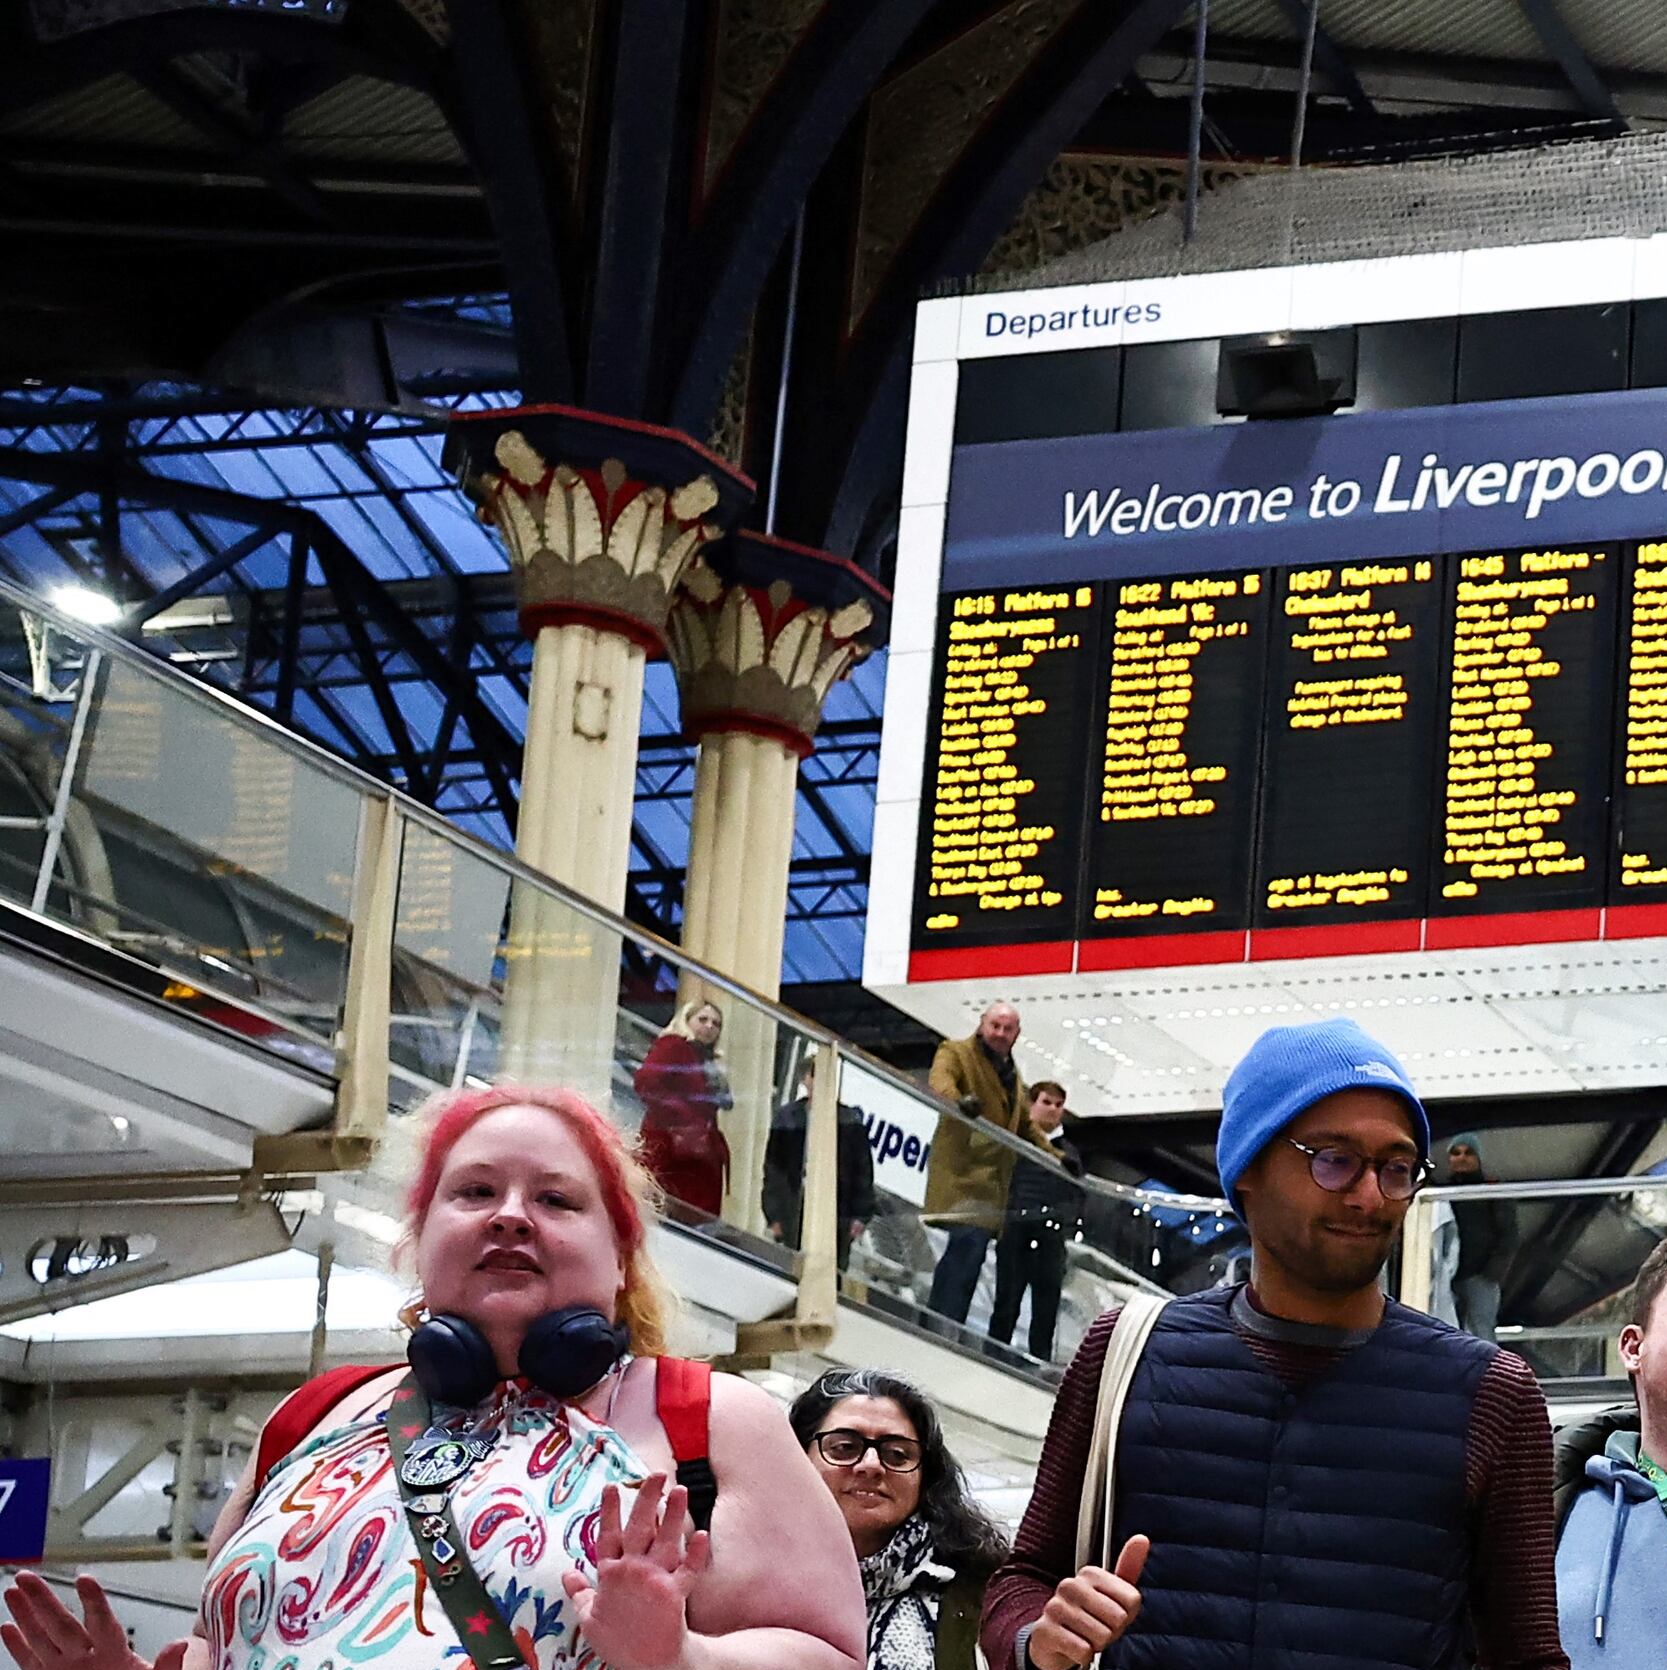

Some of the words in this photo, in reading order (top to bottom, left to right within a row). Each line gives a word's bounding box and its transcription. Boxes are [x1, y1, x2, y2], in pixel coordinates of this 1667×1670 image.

[985, 298, 1162, 339] Departures
[1063, 483, 1292, 539] Welcome
[1309, 473, 1361, 519] to
[1521, 551, 1589, 572] Platform
[1341, 566, 1407, 586] Platform
[1171, 579, 1236, 599] Platform
[1005, 592, 1069, 612] Platform
